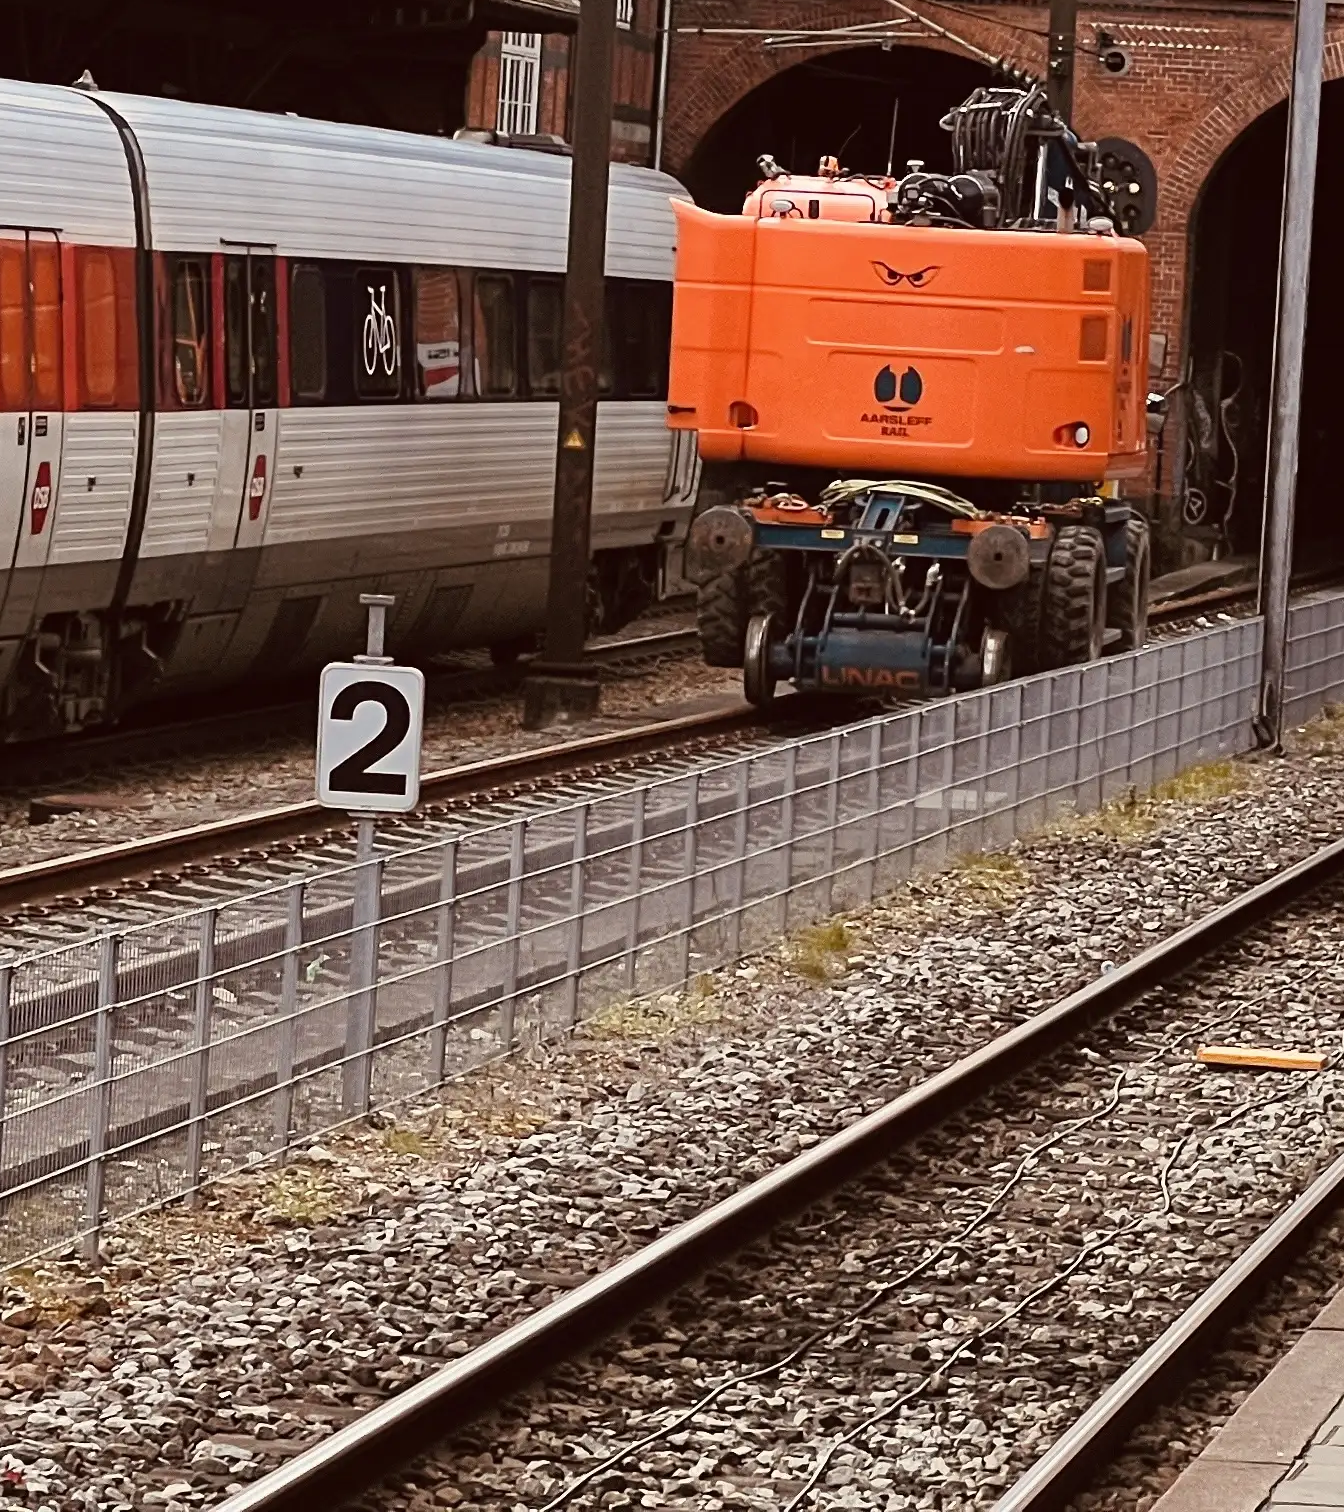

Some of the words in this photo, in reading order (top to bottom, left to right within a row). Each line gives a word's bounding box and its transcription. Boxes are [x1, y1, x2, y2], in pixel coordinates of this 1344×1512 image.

[860, 413, 933, 426] AARSLEFF
[881, 426, 910, 438] RAIL
[250, 476, 265, 497] DSB
[33, 486, 50, 510] DSB
[328, 680, 411, 796] 2
